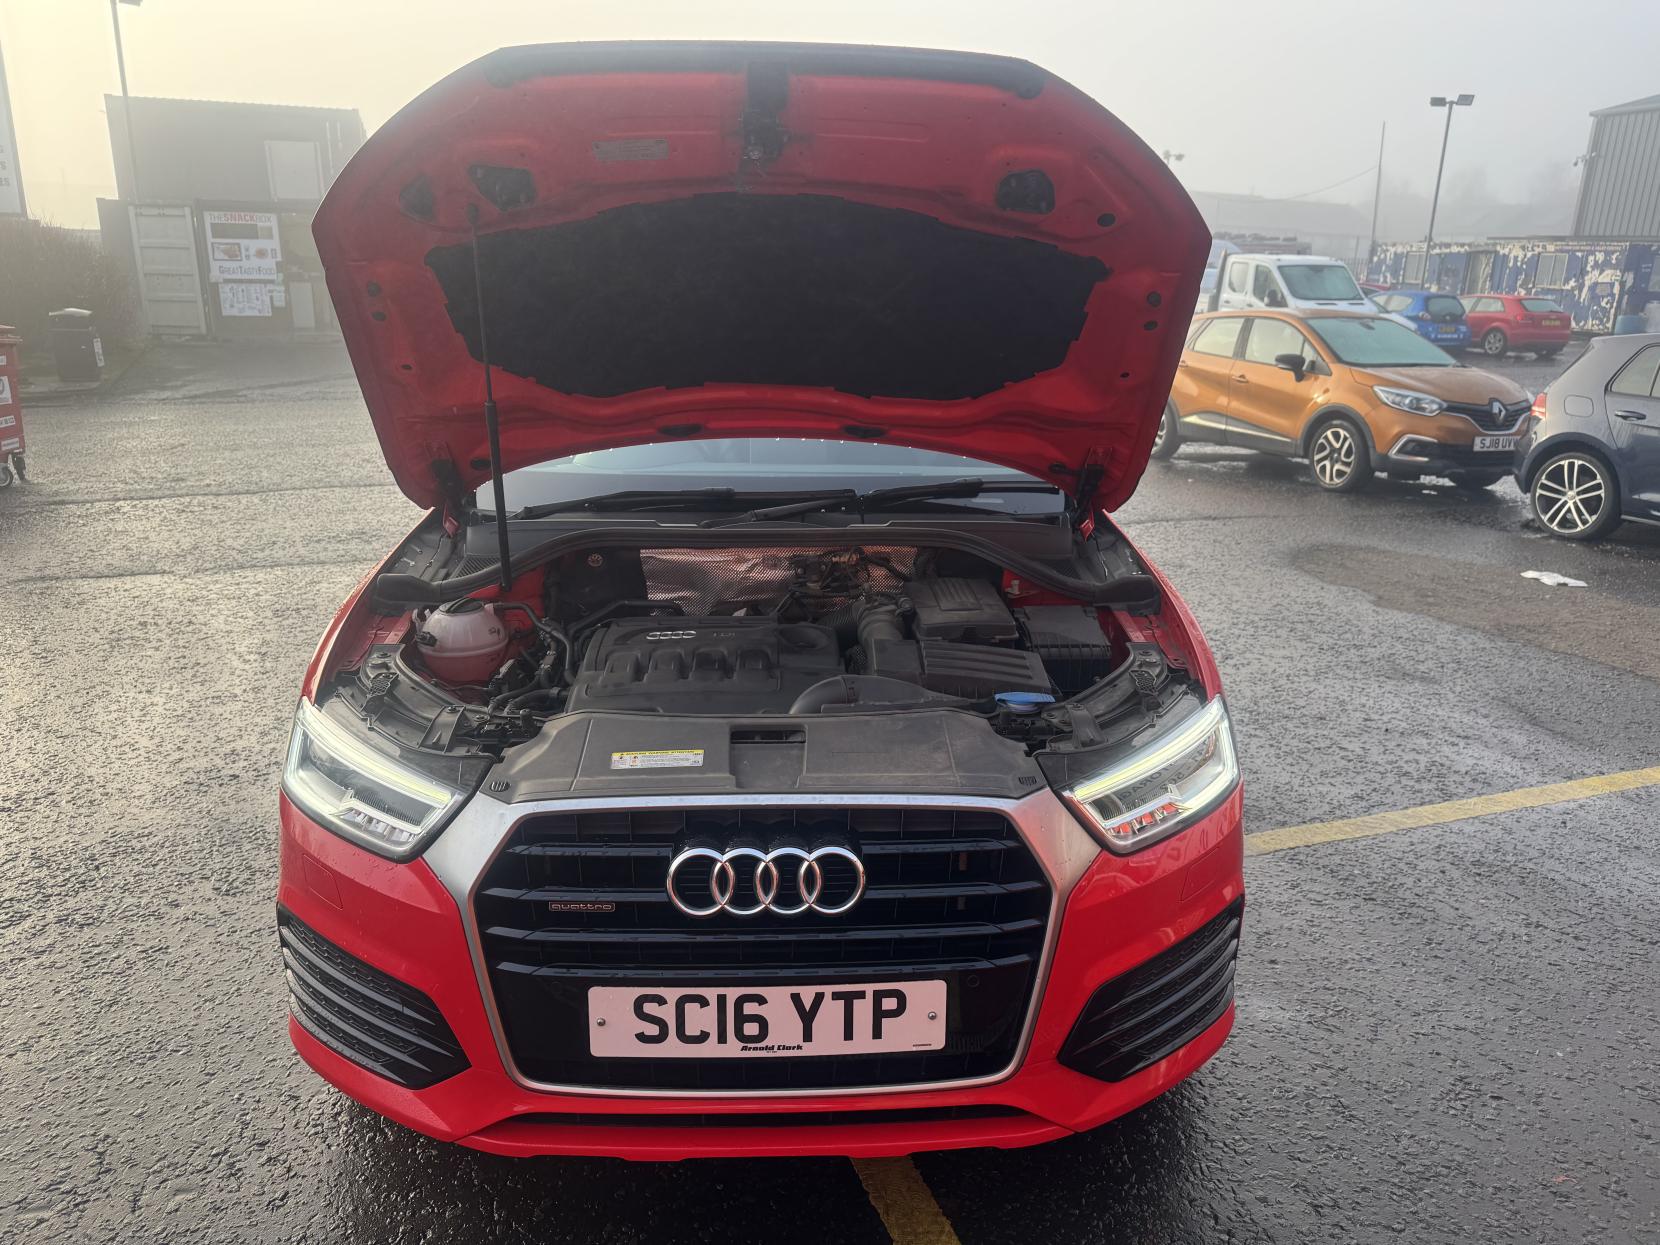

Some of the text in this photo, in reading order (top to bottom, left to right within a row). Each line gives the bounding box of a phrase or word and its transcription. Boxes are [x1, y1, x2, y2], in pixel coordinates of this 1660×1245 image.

[1480, 438, 1500, 449] SJ18
[551, 903, 612, 912] quattro
[633, 988, 908, 1045] SC16 YTP
[740, 1044, 775, 1052] Arnold
